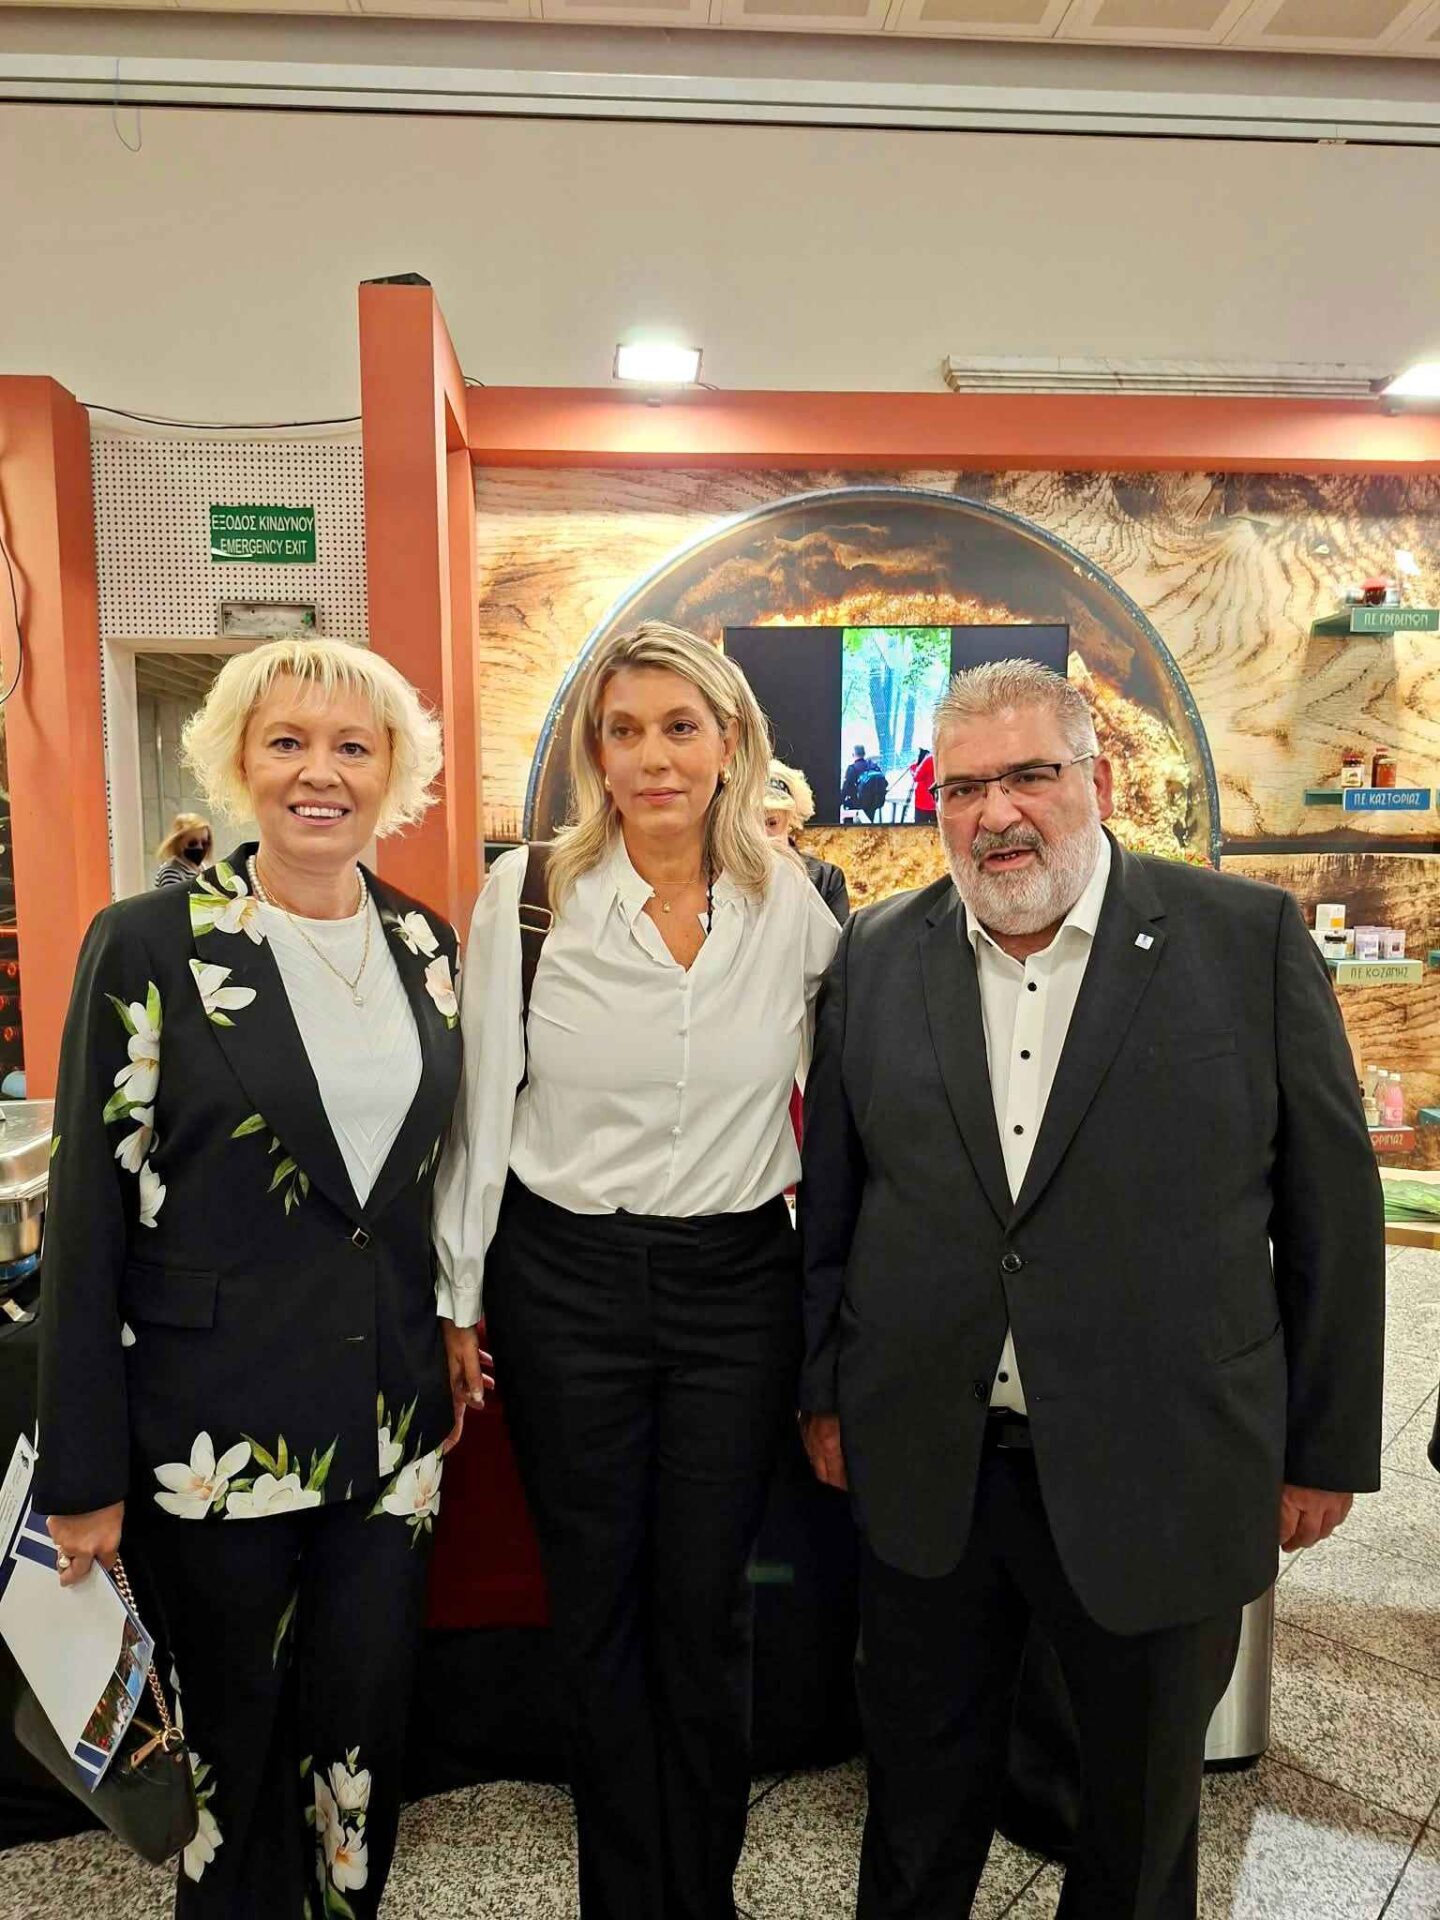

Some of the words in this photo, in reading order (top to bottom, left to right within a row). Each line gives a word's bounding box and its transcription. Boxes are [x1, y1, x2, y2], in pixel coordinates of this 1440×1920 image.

[211, 514, 257, 531] ΕΞΟΔΟΣ
[259, 515, 314, 532] ΚΙΝΔΥΝΟΥ
[220, 538, 283, 555] EMERGENCY
[285, 540, 308, 555] EXIT
[1369, 793, 1420, 806] ΚΑΣΤΟΡΙΑΣ
[1370, 1133, 1404, 1146] ΩΡΙΝΑΣ
